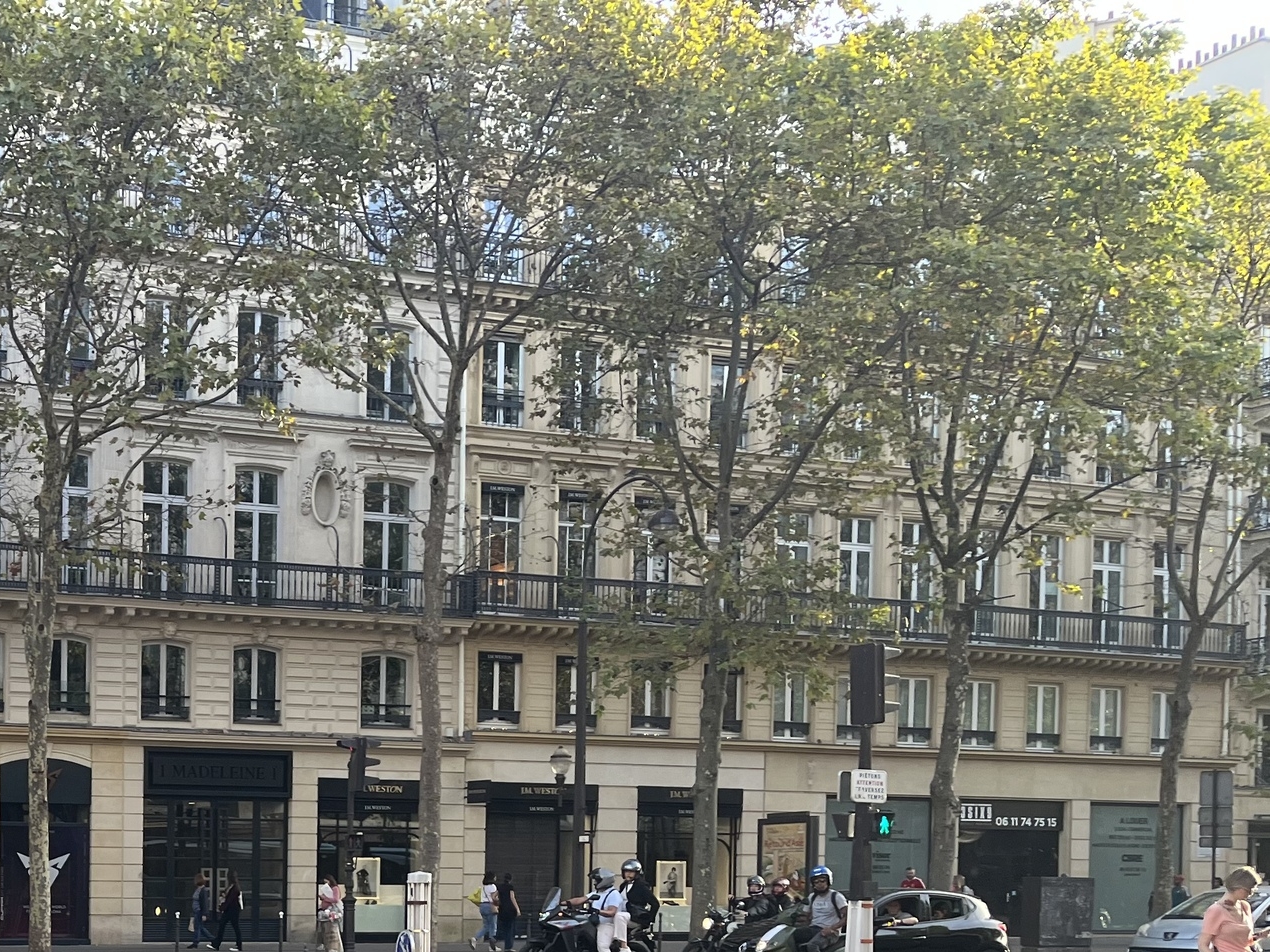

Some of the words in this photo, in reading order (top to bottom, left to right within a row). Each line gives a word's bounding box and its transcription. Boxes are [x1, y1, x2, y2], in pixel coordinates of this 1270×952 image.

[172, 764, 266, 780] MADELEINE
[367, 784, 403, 794] WESTON
[995, 816, 1009, 826] 06
[1010, 817, 1019, 826] 11
[1020, 817, 1032, 827] 74
[1034, 817, 1045, 827] 75
[1047, 817, 1057, 827] 15
